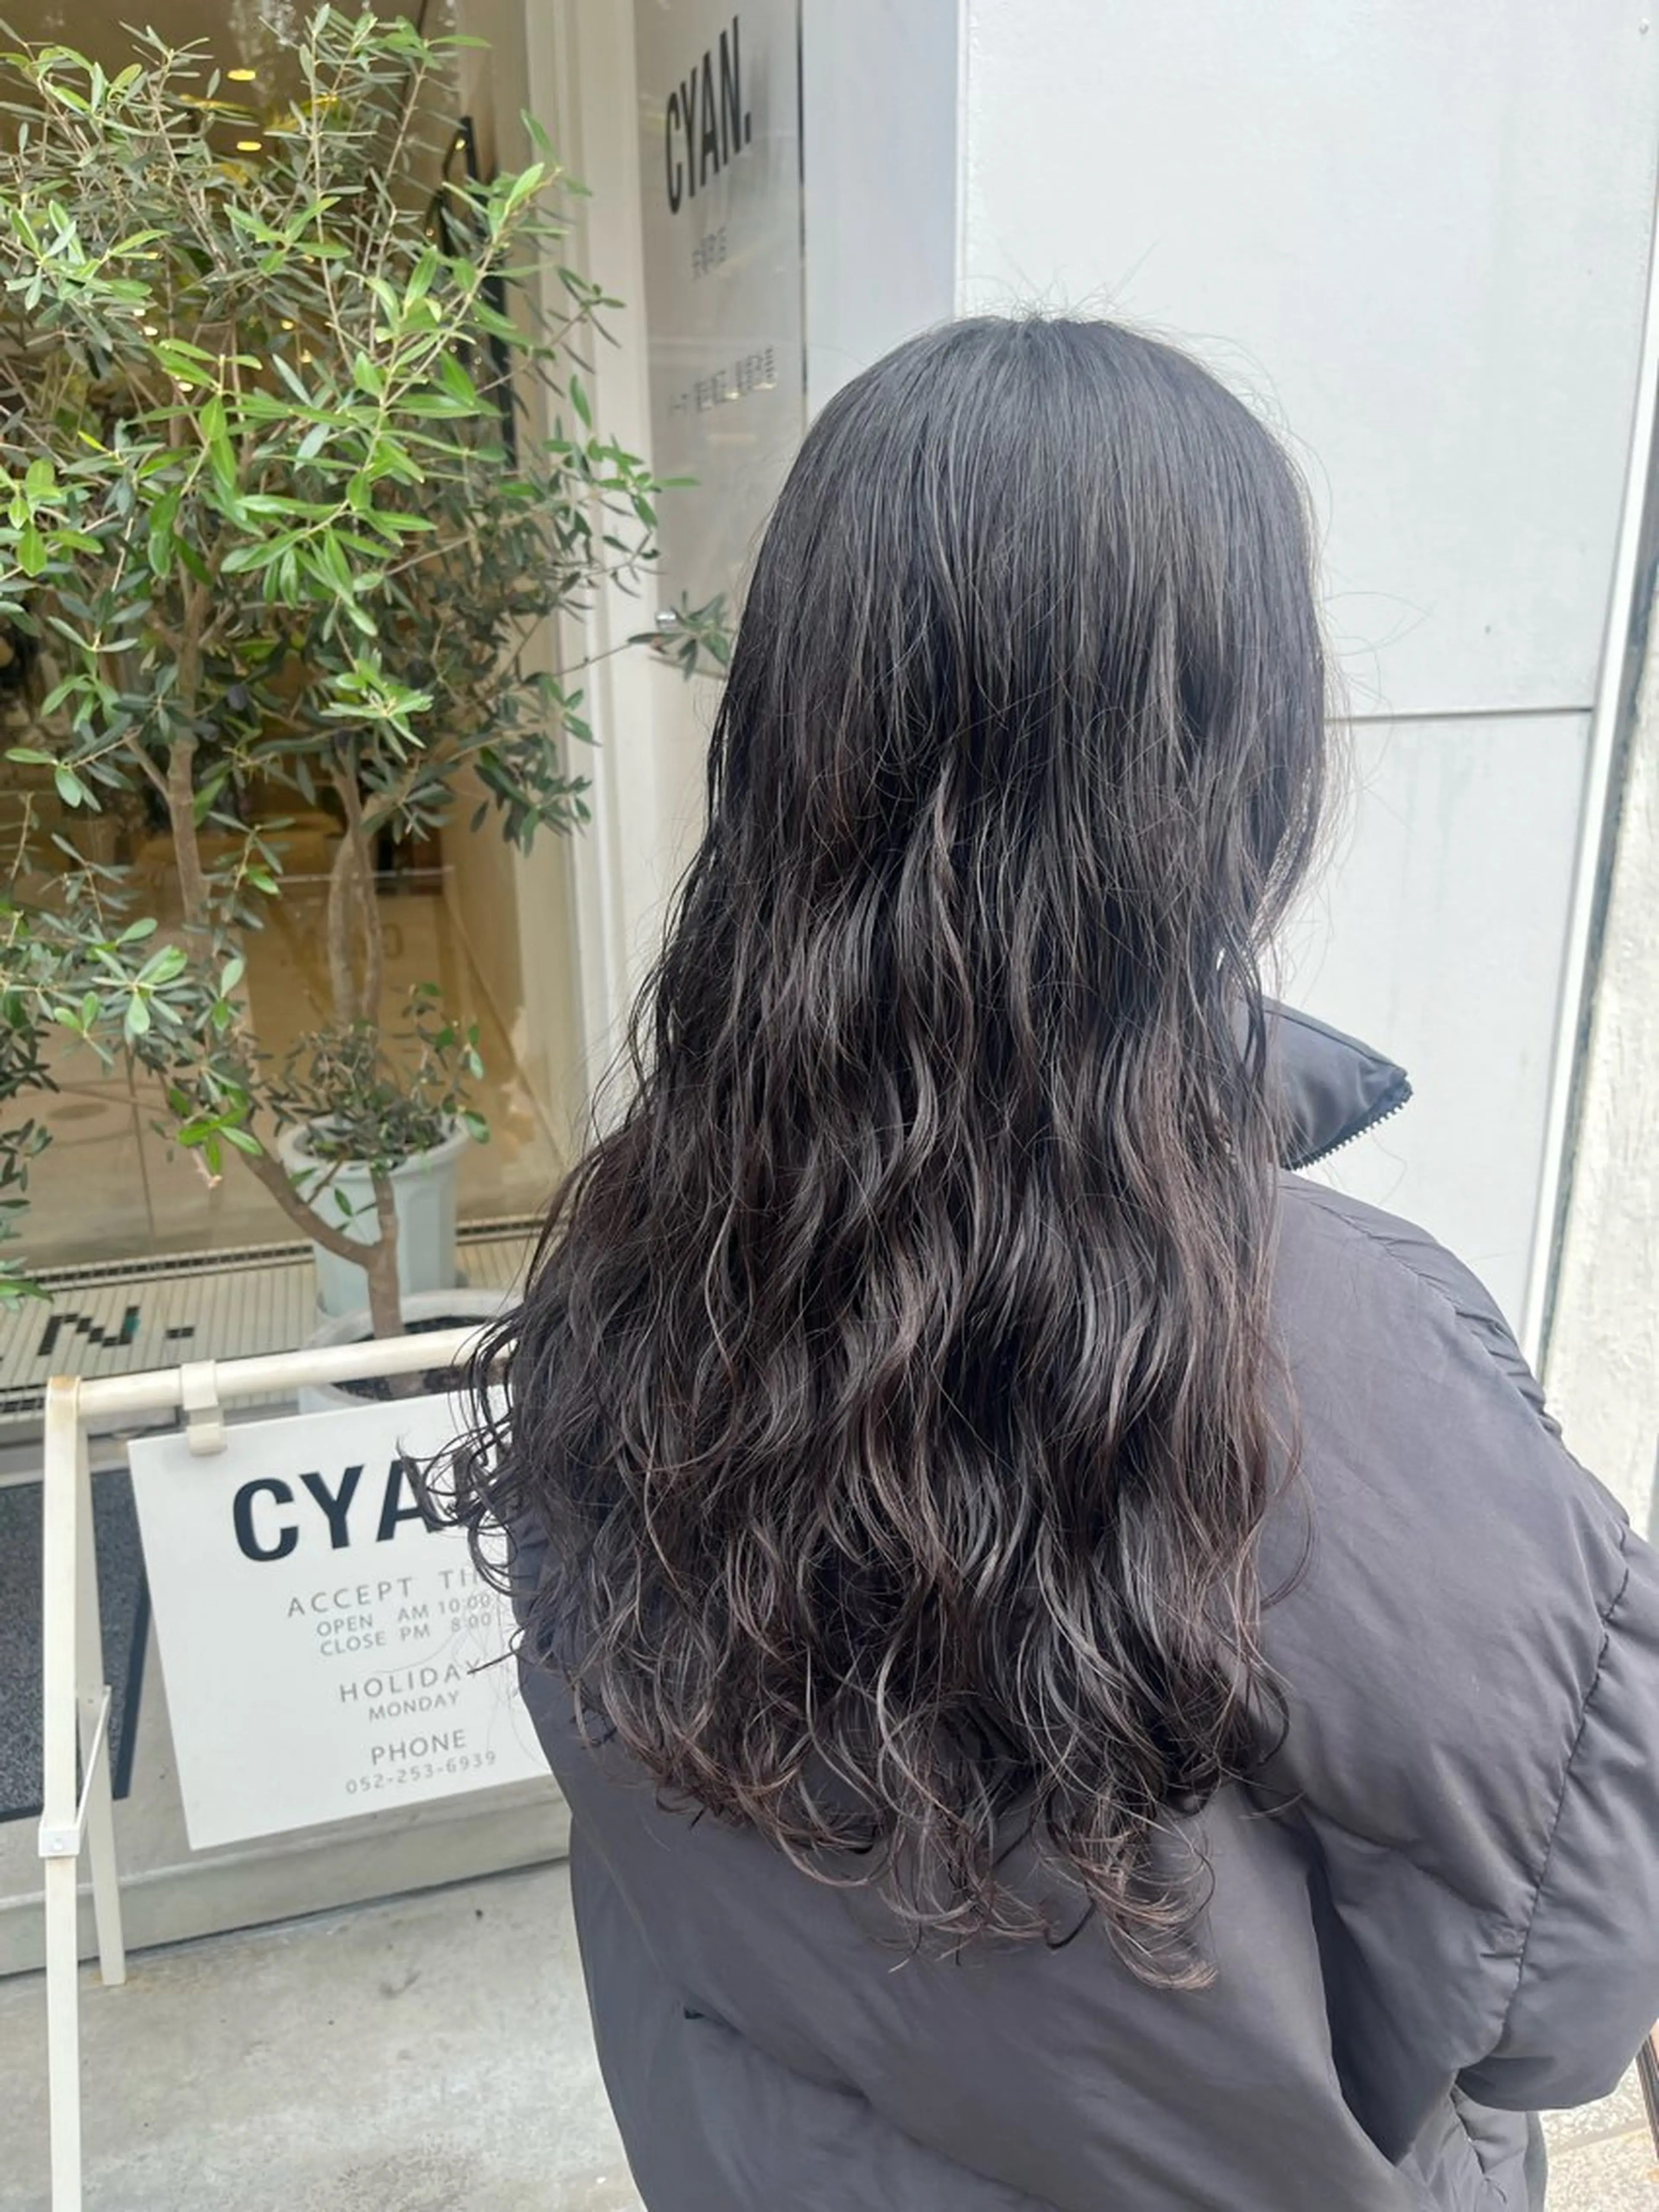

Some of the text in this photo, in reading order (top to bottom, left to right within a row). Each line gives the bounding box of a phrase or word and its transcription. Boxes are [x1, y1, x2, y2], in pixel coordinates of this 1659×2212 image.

[665, 14, 750, 215] CYAN.
[287, 1577, 413, 1617] ACCEPT
[317, 1614, 373, 1637] OPEN
[397, 1604, 429, 1623] AM
[320, 1631, 387, 1656] CLOSE
[399, 1624, 430, 1641] PM
[340, 1658, 480, 1702] HOLIDAY
[369, 1690, 459, 1722] MONDAY
[371, 1729, 467, 1766] PHONE
[346, 1750, 496, 1794] 052-253-6939
